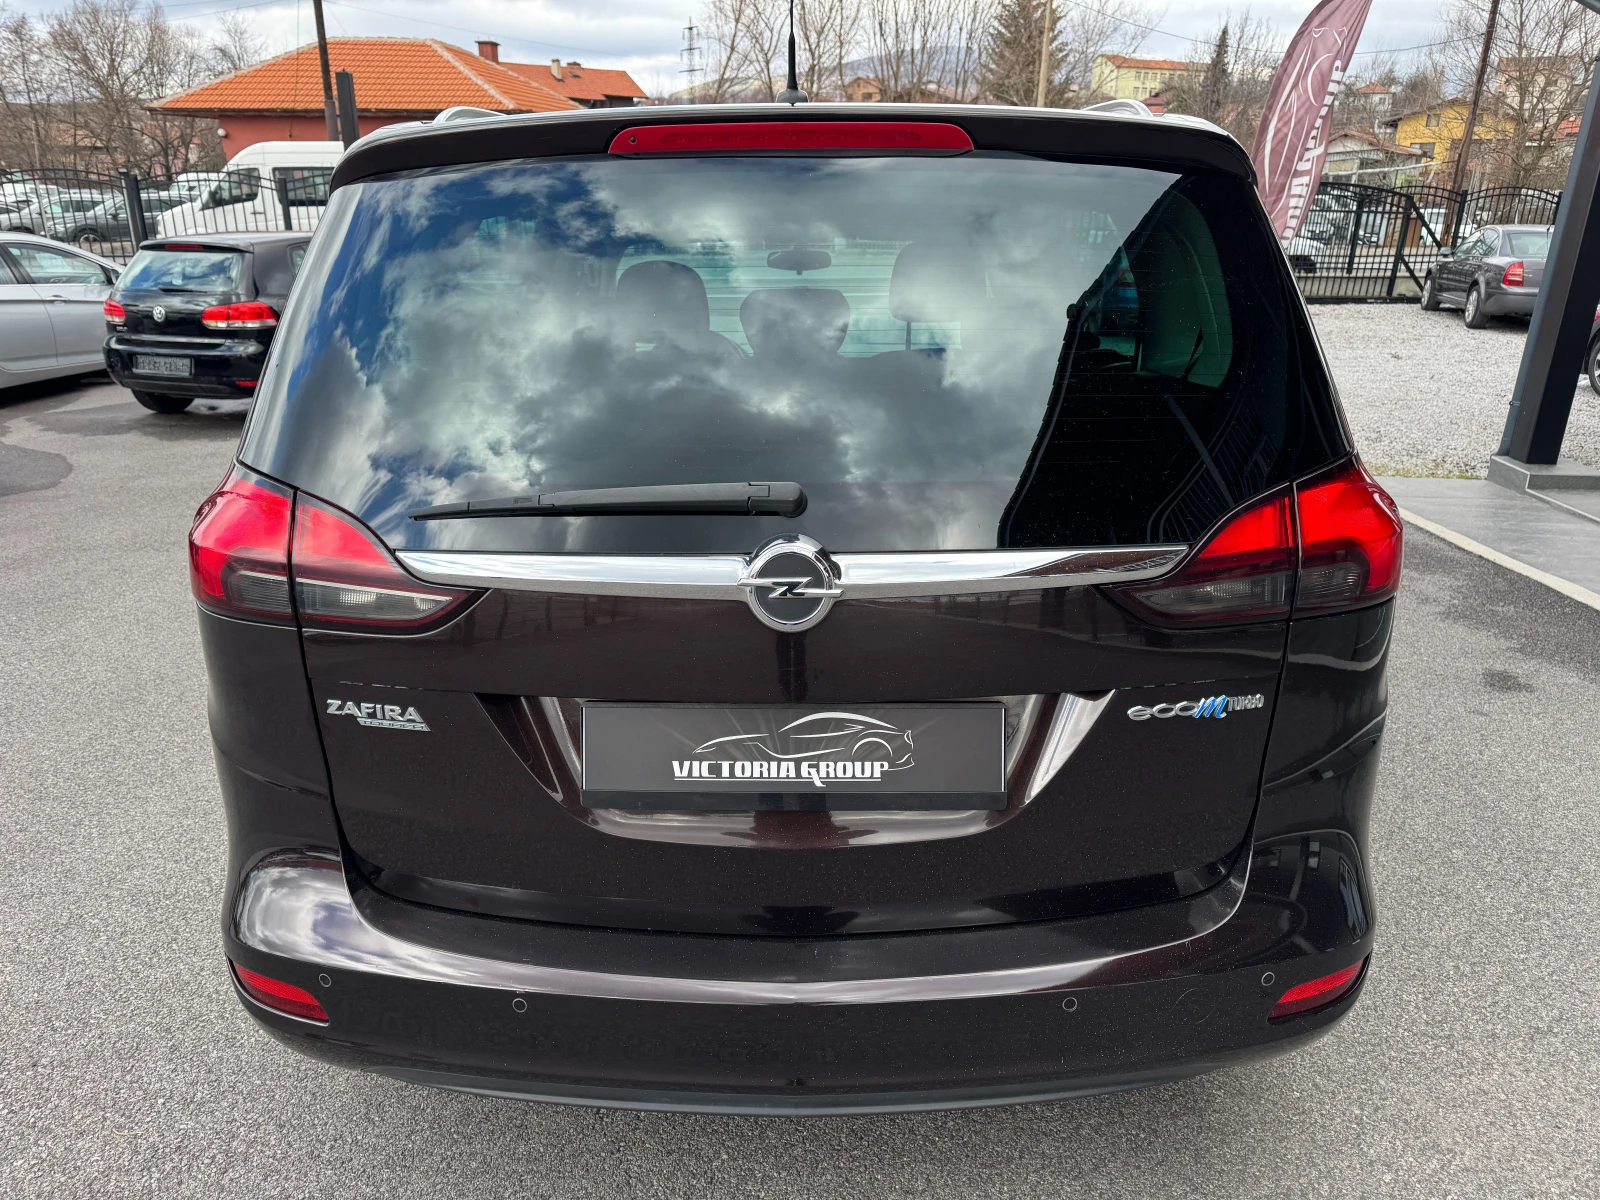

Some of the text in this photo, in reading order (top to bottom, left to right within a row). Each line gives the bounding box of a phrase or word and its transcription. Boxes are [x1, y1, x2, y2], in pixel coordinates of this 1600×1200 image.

[326, 699, 424, 723] ZAFIRA
[1228, 693, 1265, 712] TURBO
[672, 760, 889, 787] VICTORIA GROUP
